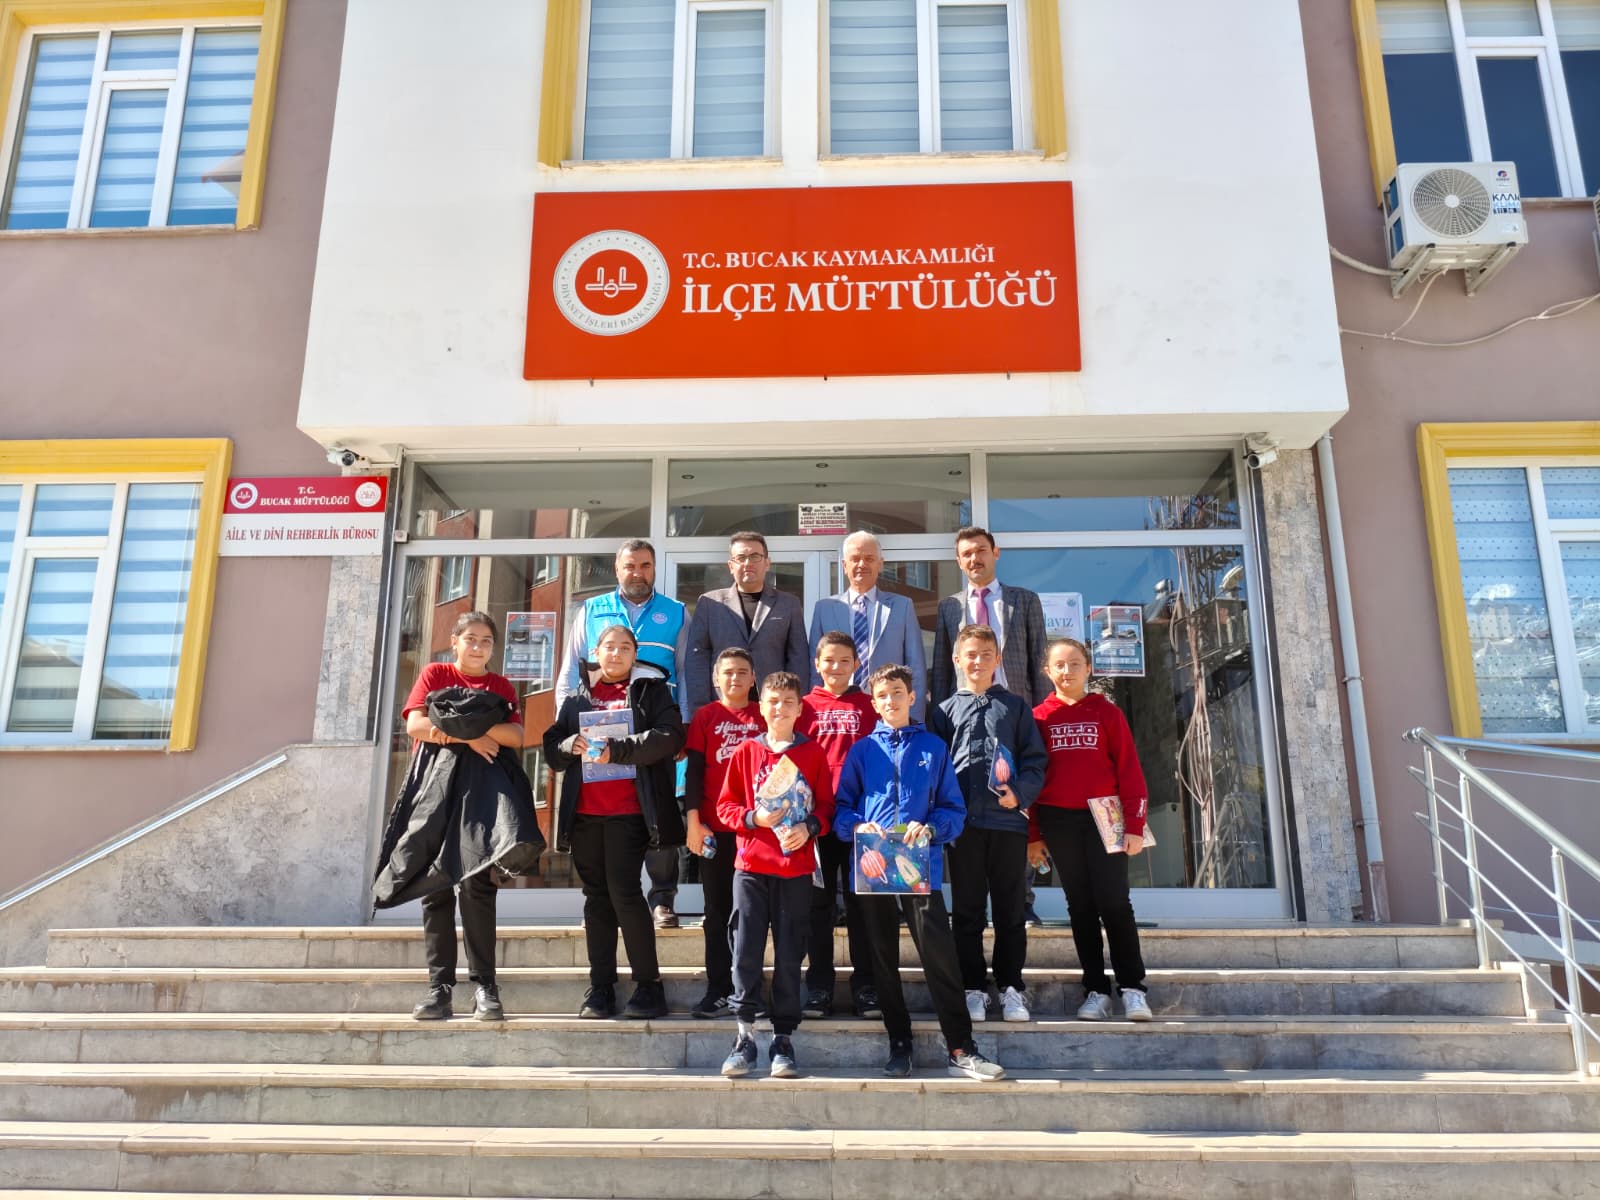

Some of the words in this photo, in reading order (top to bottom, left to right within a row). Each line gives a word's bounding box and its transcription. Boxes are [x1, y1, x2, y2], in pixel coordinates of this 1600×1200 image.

[682, 252, 721, 269] T.C.
[725, 250, 809, 268] BUCAK
[811, 243, 996, 268] KAYMAKAMLIĞI
[682, 276, 776, 321] İLÇE
[784, 269, 1057, 312] MÜFTÜLÜĞÜ
[259, 497, 292, 506] BUCAK
[225, 526, 247, 541] AİLE
[250, 529, 261, 541] VE
[264, 526, 285, 541] DİNİ
[286, 525, 339, 541] REHBERLİK
[342, 526, 379, 540] BÜROSU
